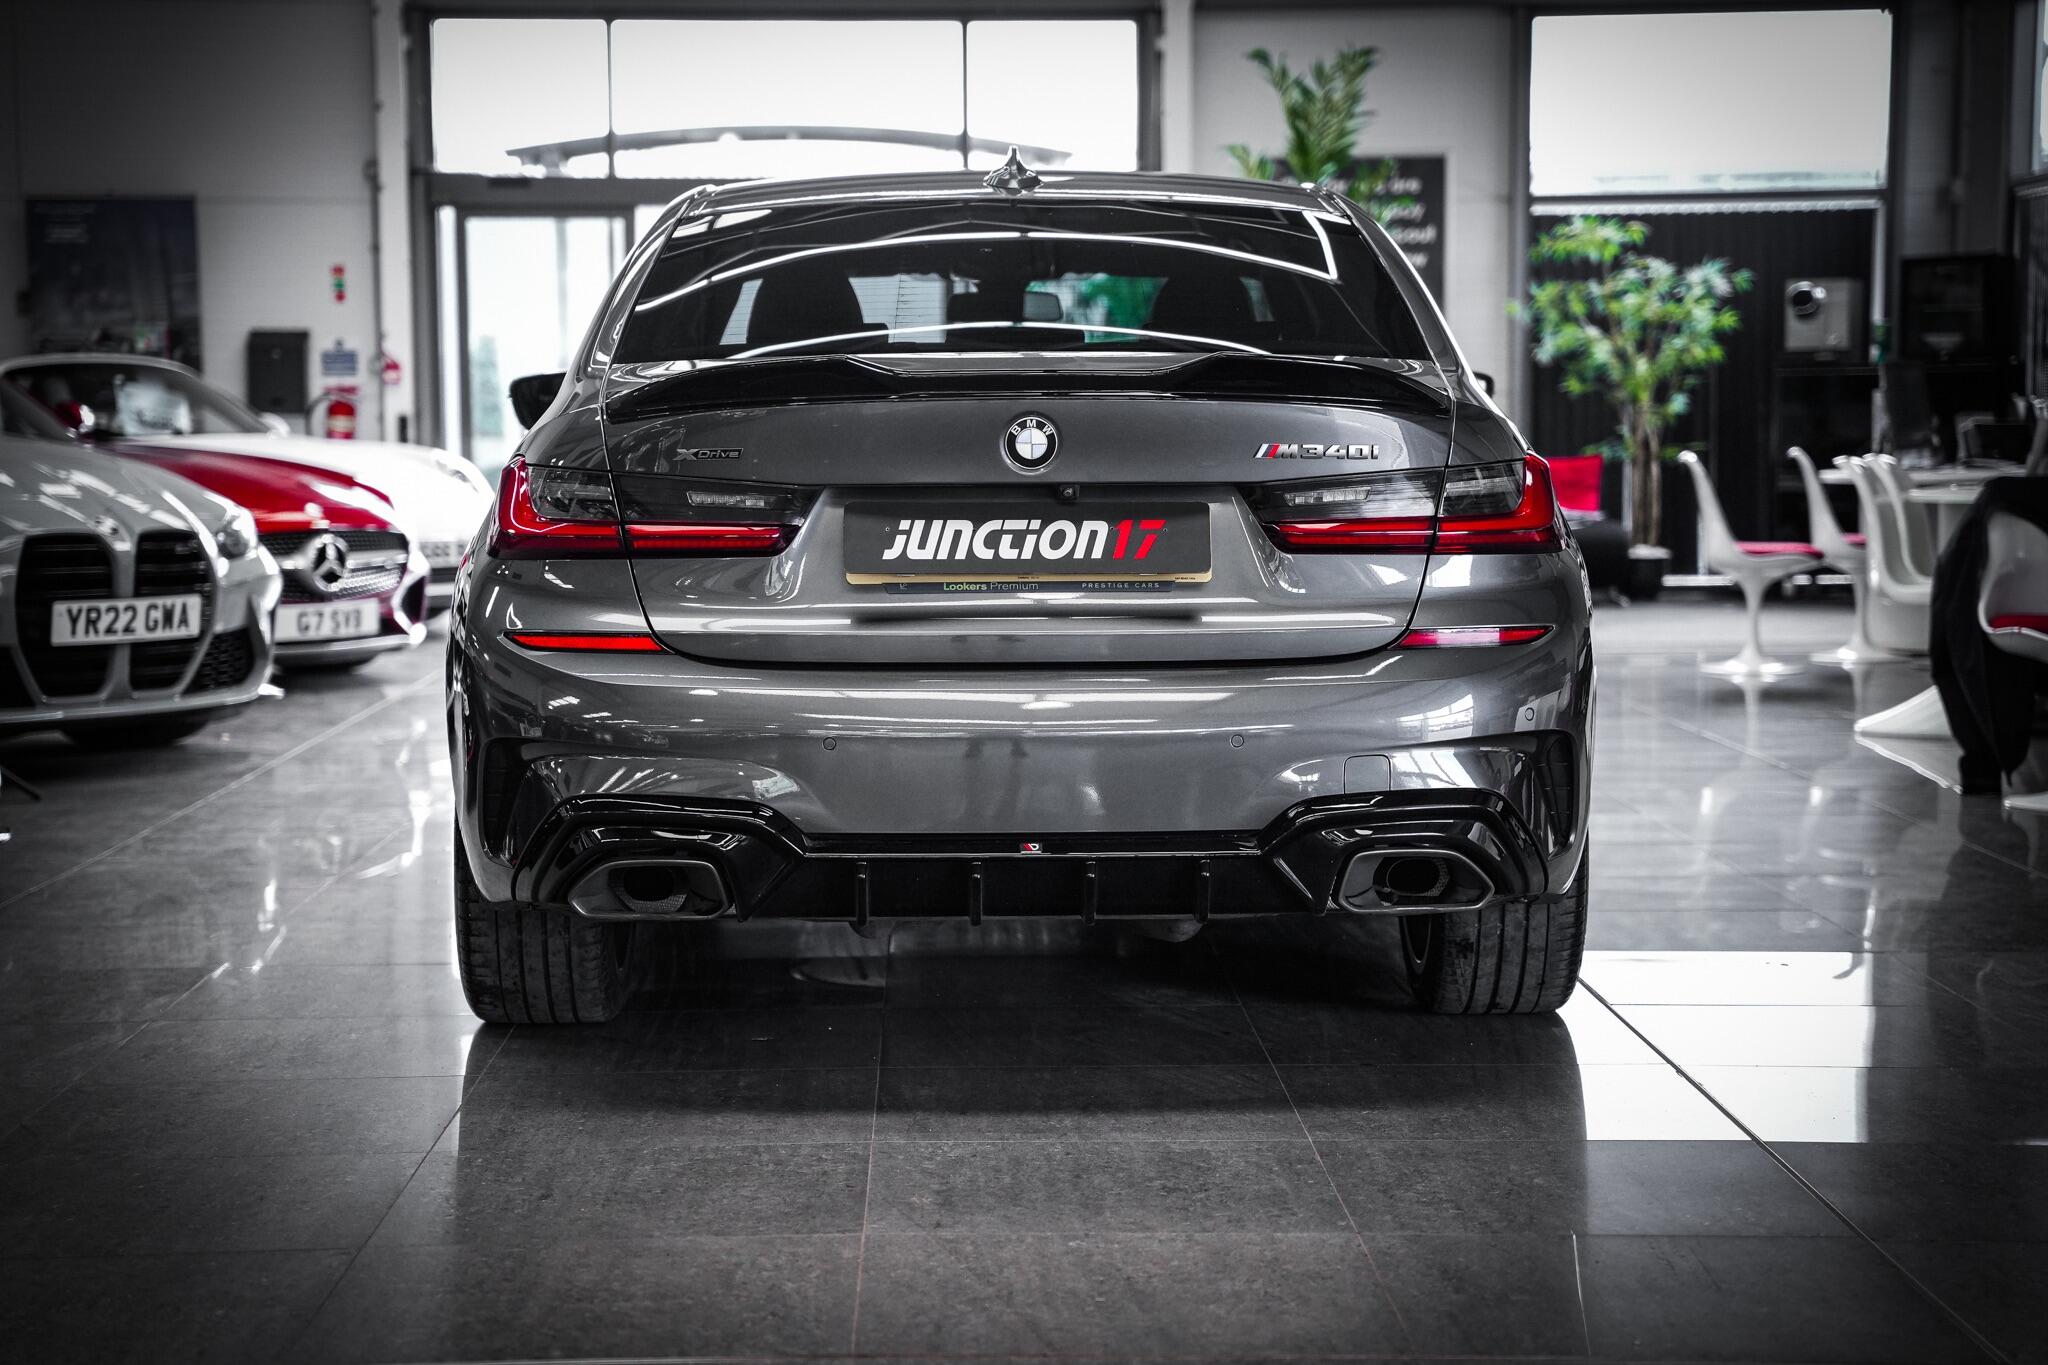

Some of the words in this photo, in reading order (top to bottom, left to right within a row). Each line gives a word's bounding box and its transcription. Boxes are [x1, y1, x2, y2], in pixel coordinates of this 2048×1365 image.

[1011, 419, 1054, 436] BMW
[943, 582, 988, 591] Lookers
[990, 582, 1039, 591] Premium
[66, 605, 137, 638] YR22
[145, 601, 189, 632] GWA
